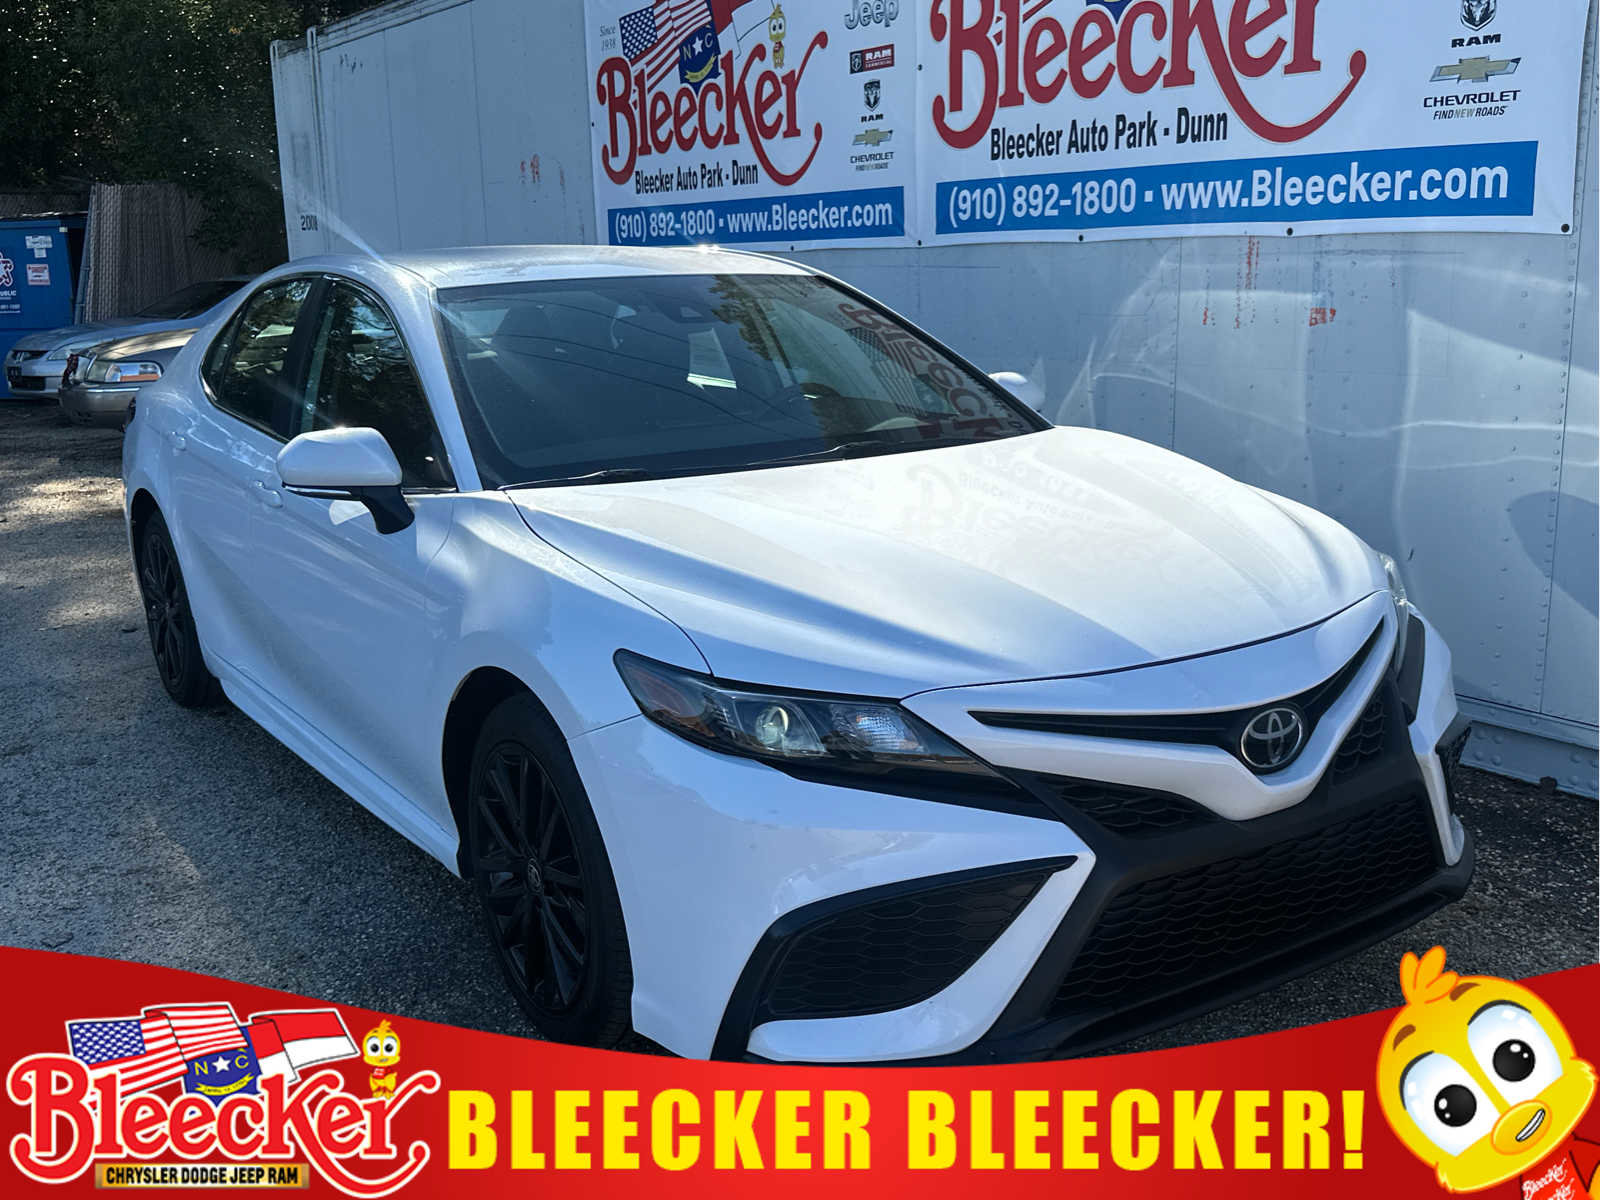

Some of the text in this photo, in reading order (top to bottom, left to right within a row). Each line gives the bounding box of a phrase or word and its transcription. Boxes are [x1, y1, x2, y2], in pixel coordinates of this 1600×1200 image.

[844, 0, 899, 30] Jeep
[1451, 33, 1501, 48] RAM
[865, 49, 892, 61] RAM
[1423, 90, 1520, 108] CHEVROLET
[861, 113, 884, 123] RAM
[990, 106, 1228, 160] Bleecker Auto Park Dunn
[850, 151, 894, 164] CHEVROLET
[635, 159, 758, 194] Bleecker Auto Park Dunn
[949, 161, 1508, 228] (910) 892-1800 www.Bleecker.com
[614, 200, 893, 243] (910) 892-1800 www.Bleecker.com
